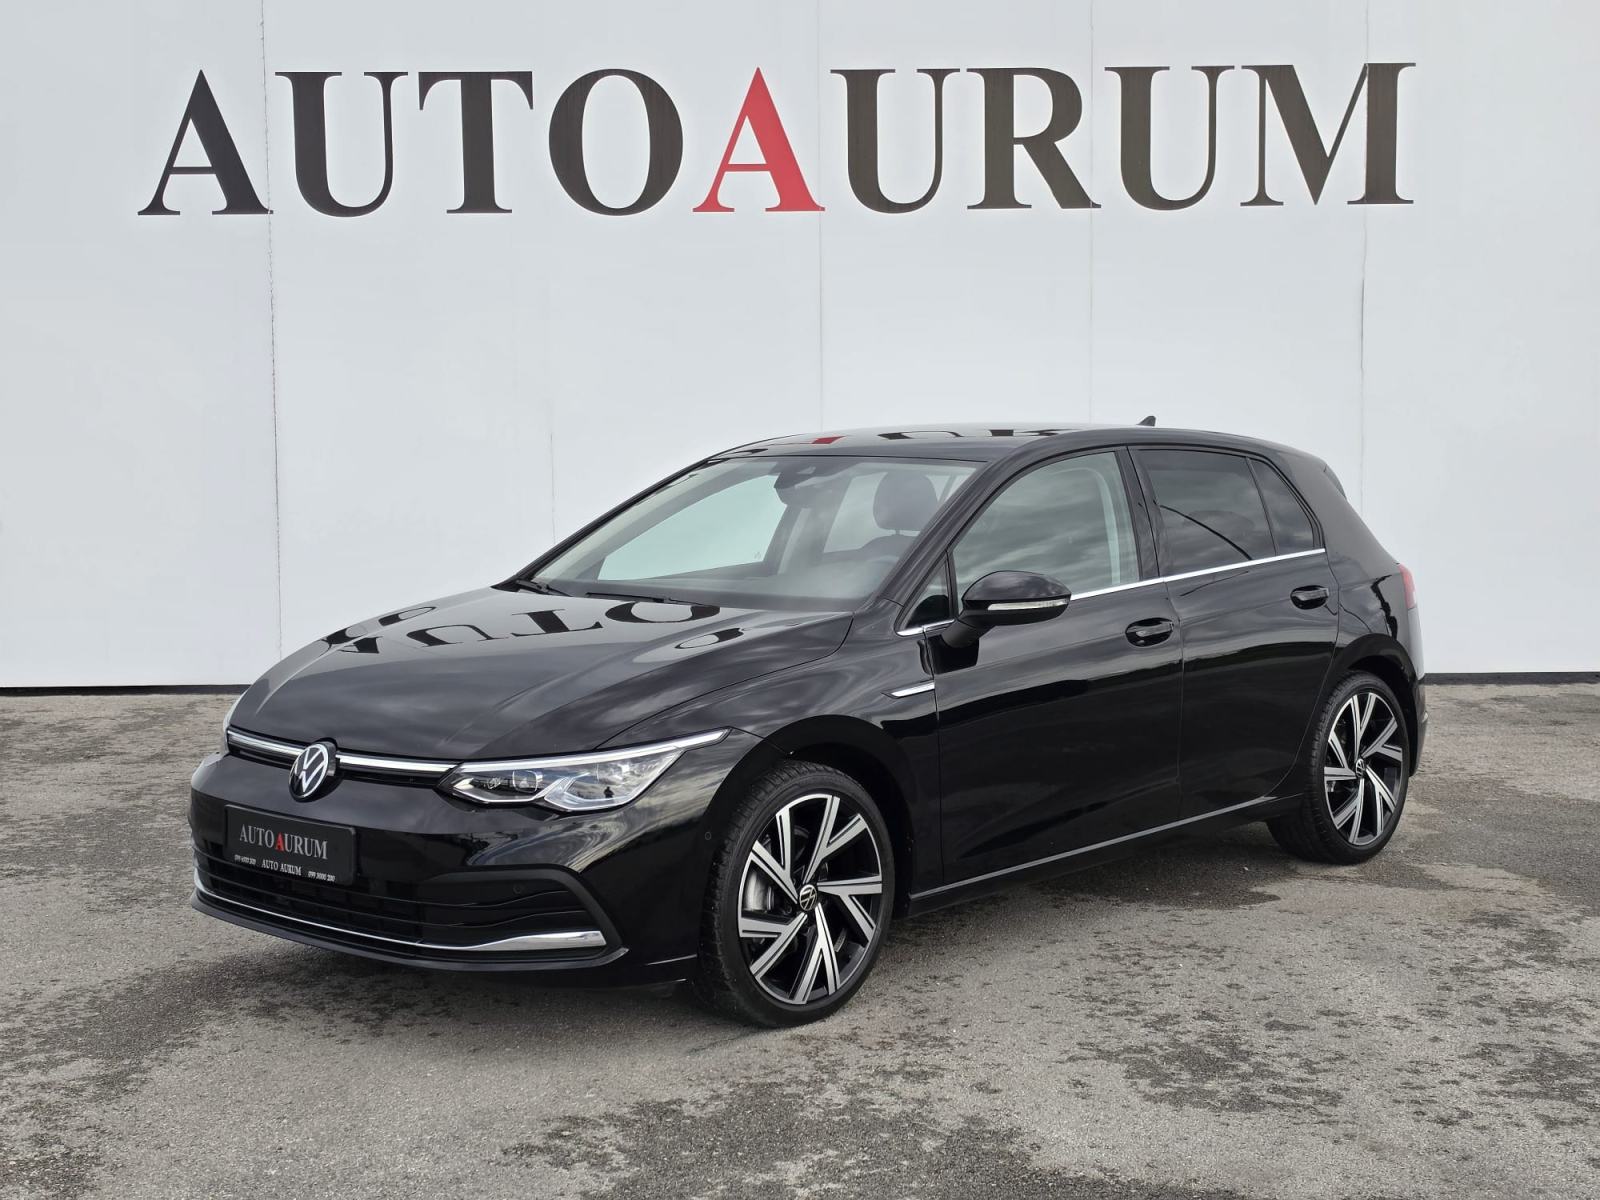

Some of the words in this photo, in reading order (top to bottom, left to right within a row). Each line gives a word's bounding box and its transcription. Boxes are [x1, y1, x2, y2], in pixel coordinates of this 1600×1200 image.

[138, 62, 1416, 217] AUTOAURUM
[239, 823, 328, 860] AUTOAURUM
[261, 859, 279, 871] AUTO
[280, 863, 302, 876] AURUM
